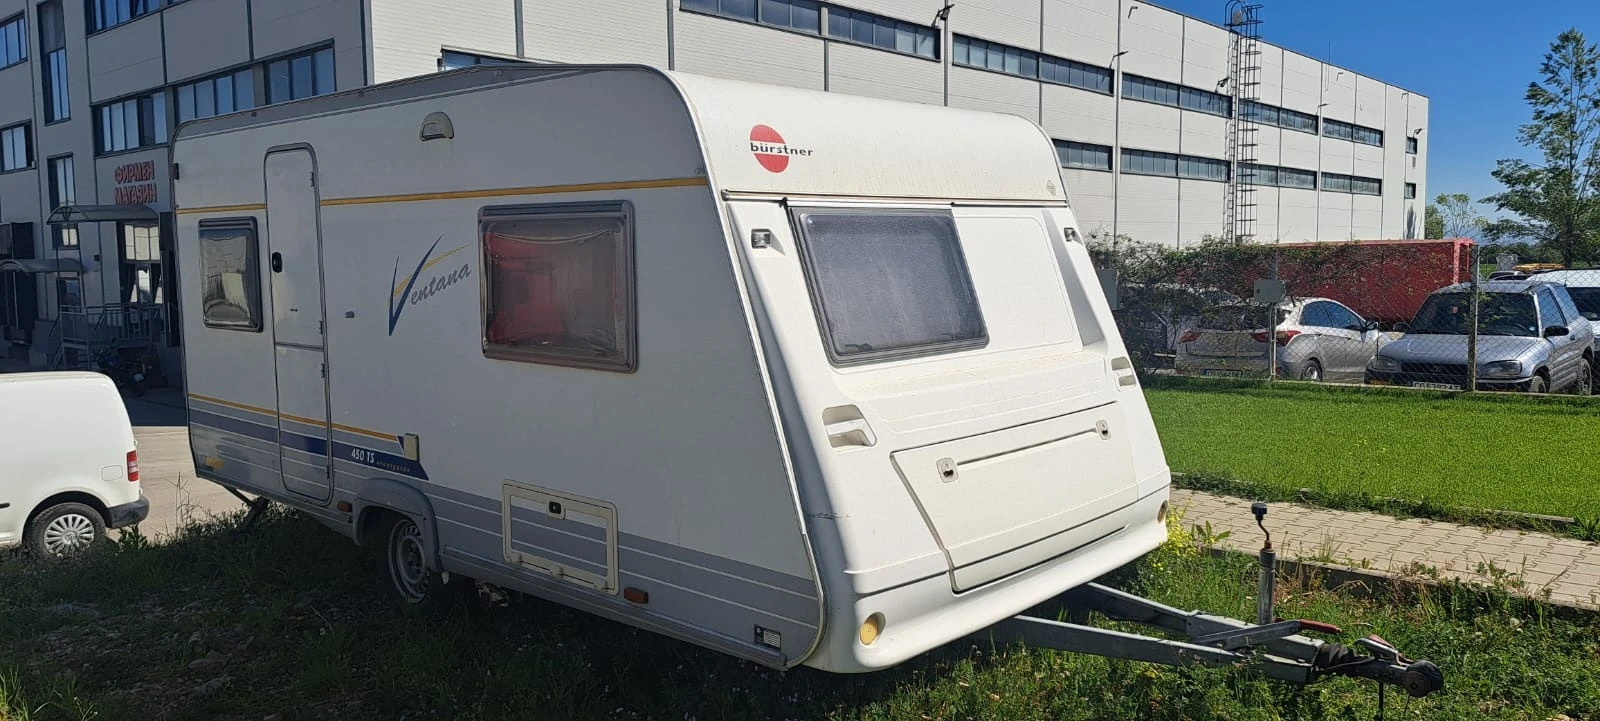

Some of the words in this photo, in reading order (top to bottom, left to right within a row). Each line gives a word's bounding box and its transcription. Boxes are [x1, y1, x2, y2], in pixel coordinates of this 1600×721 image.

[750, 142, 814, 156] bürstner
[114, 160, 155, 184] ФИРМЕН
[115, 183, 158, 206] МАГАЗИН
[388, 233, 472, 336] Ventana
[351, 447, 365, 462] 450
[366, 451, 375, 464] TS
